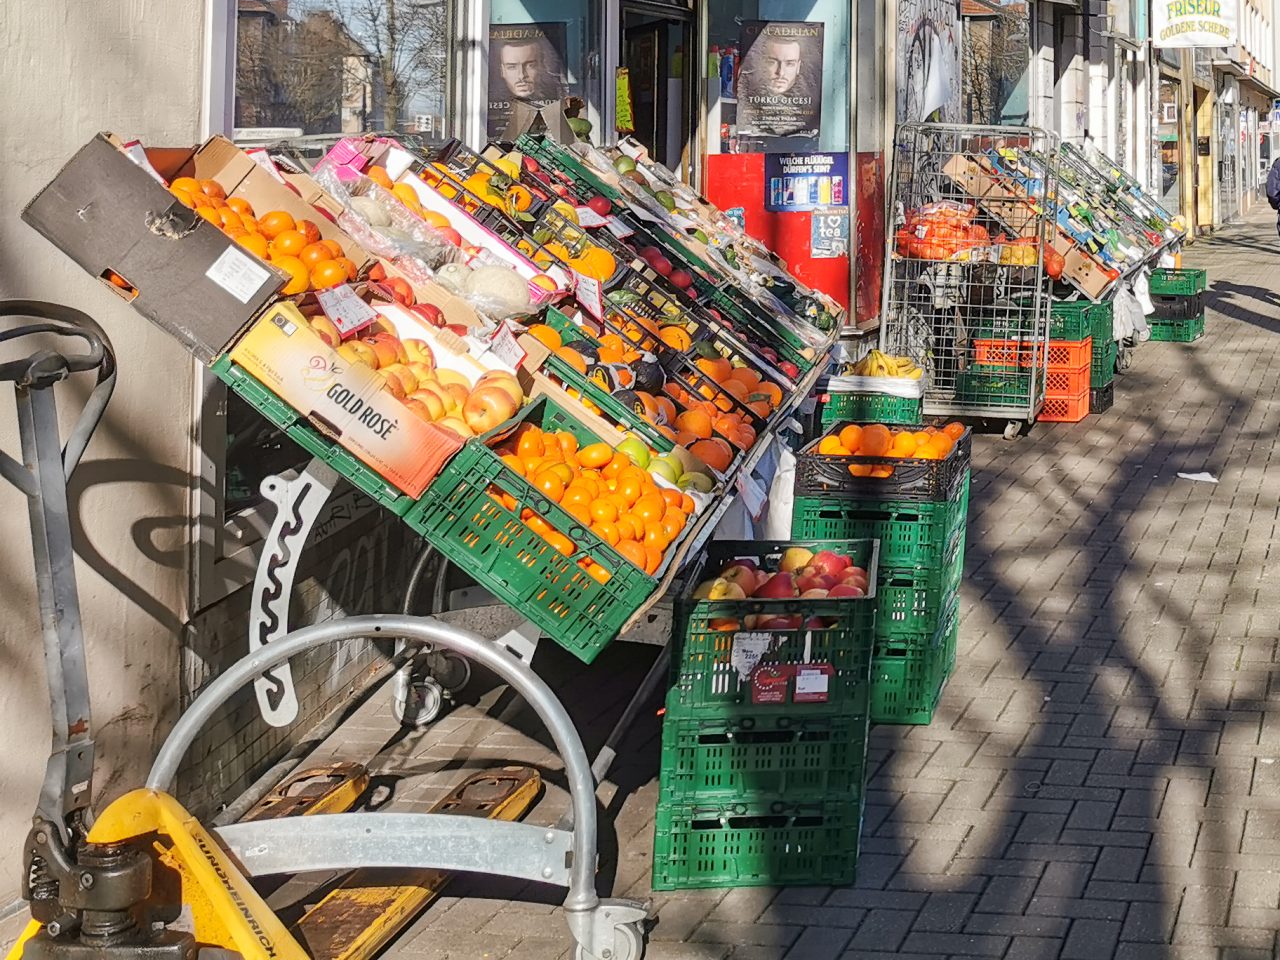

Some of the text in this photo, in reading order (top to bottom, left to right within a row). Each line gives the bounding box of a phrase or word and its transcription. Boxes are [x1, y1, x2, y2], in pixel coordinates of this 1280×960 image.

[773, 26, 819, 37] ADRIAN
[1159, 20, 1230, 41] GOLDENE SCHERE
[779, 156, 803, 165] WELCHE
[819, 226, 841, 238] tea
[326, 383, 365, 416] GOLD
